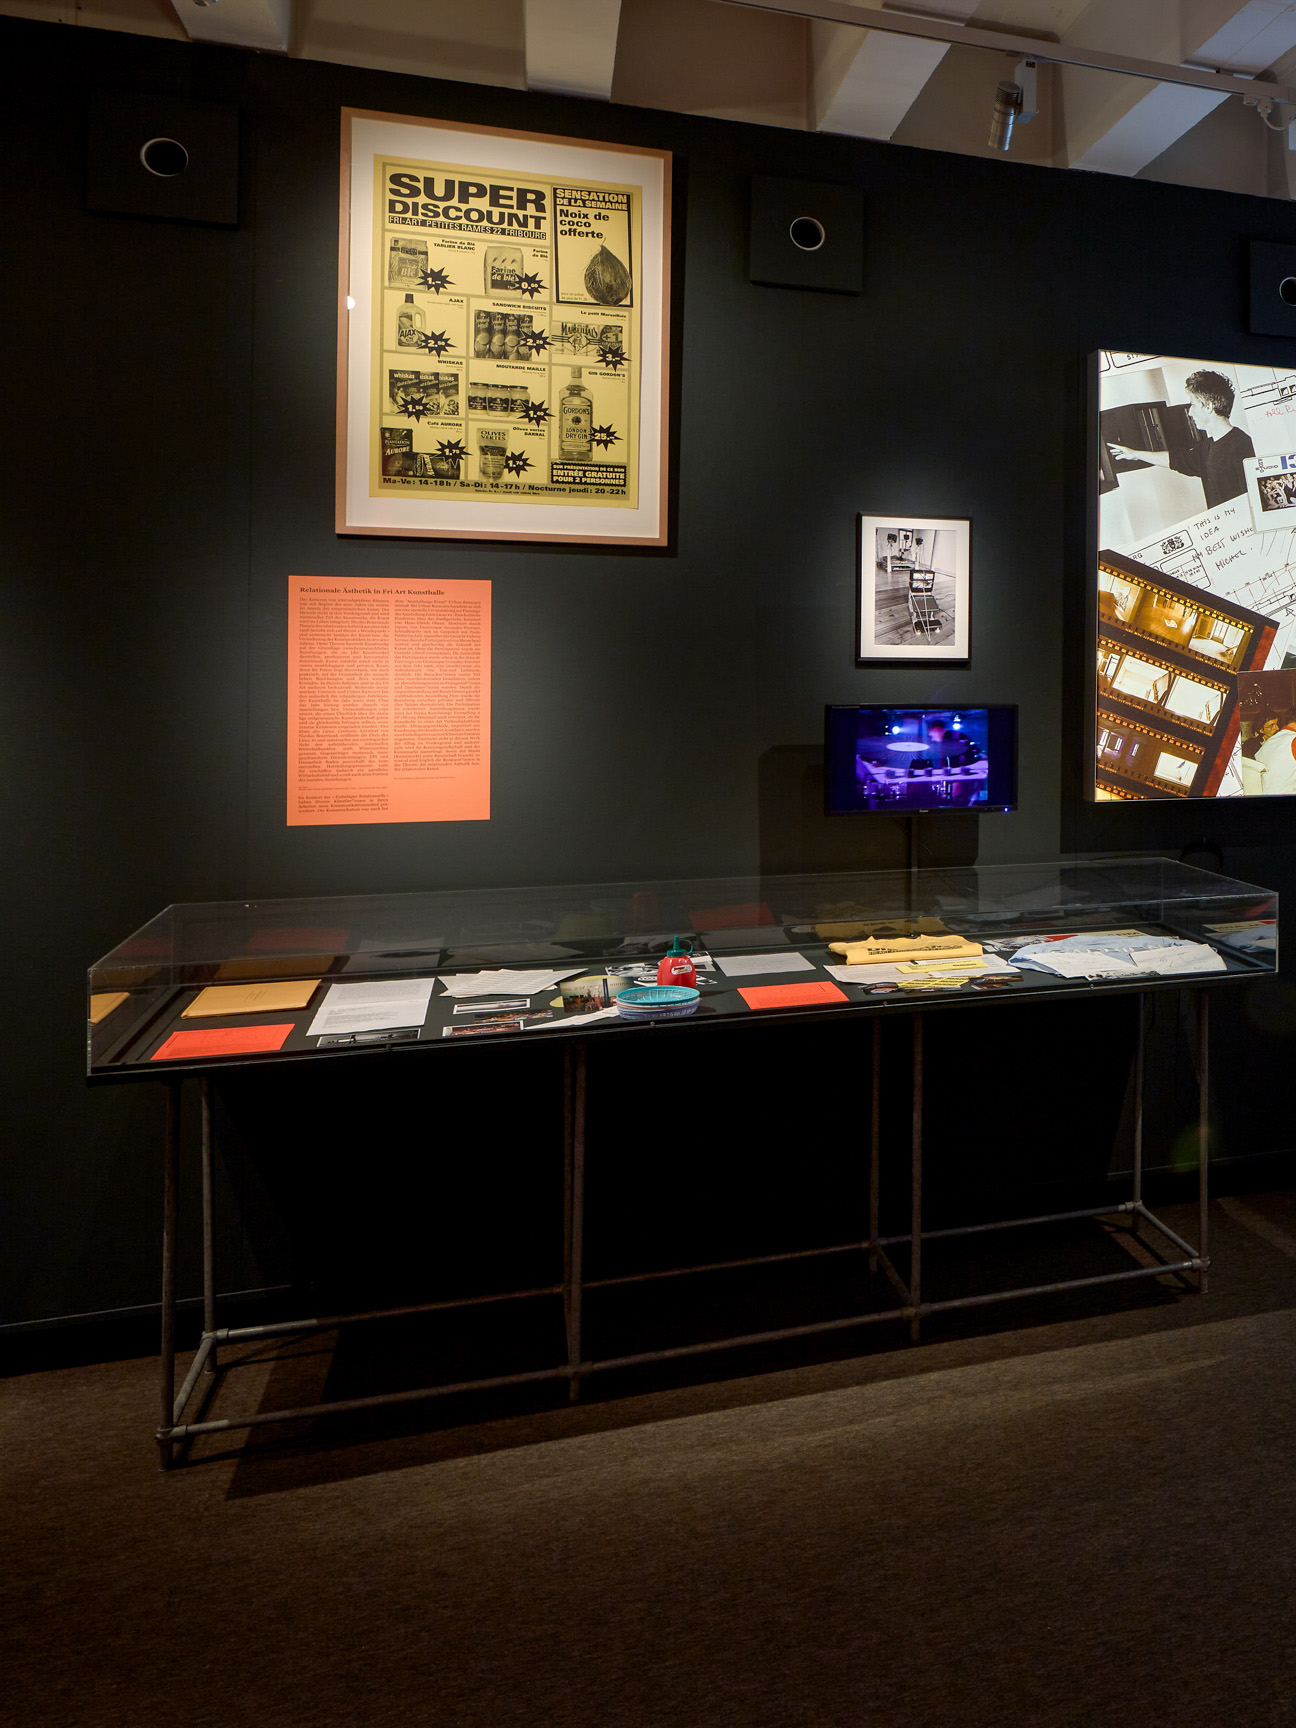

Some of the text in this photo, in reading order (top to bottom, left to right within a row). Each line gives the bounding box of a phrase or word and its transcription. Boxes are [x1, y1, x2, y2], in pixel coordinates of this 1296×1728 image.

[389, 173, 546, 213] SUPER
[556, 189, 627, 203] SENSATION
[586, 200, 628, 210] SEMAINE
[389, 199, 546, 230] DISCOUNT
[560, 209, 609, 221] Noix de
[389, 215, 546, 240] FRI-ART PETITES RAMES 22 FRIBOURG
[560, 219, 591, 228] coco
[560, 228, 603, 239] offerte
[491, 266, 516, 274] Farine
[400, 329, 416, 338] AJAX
